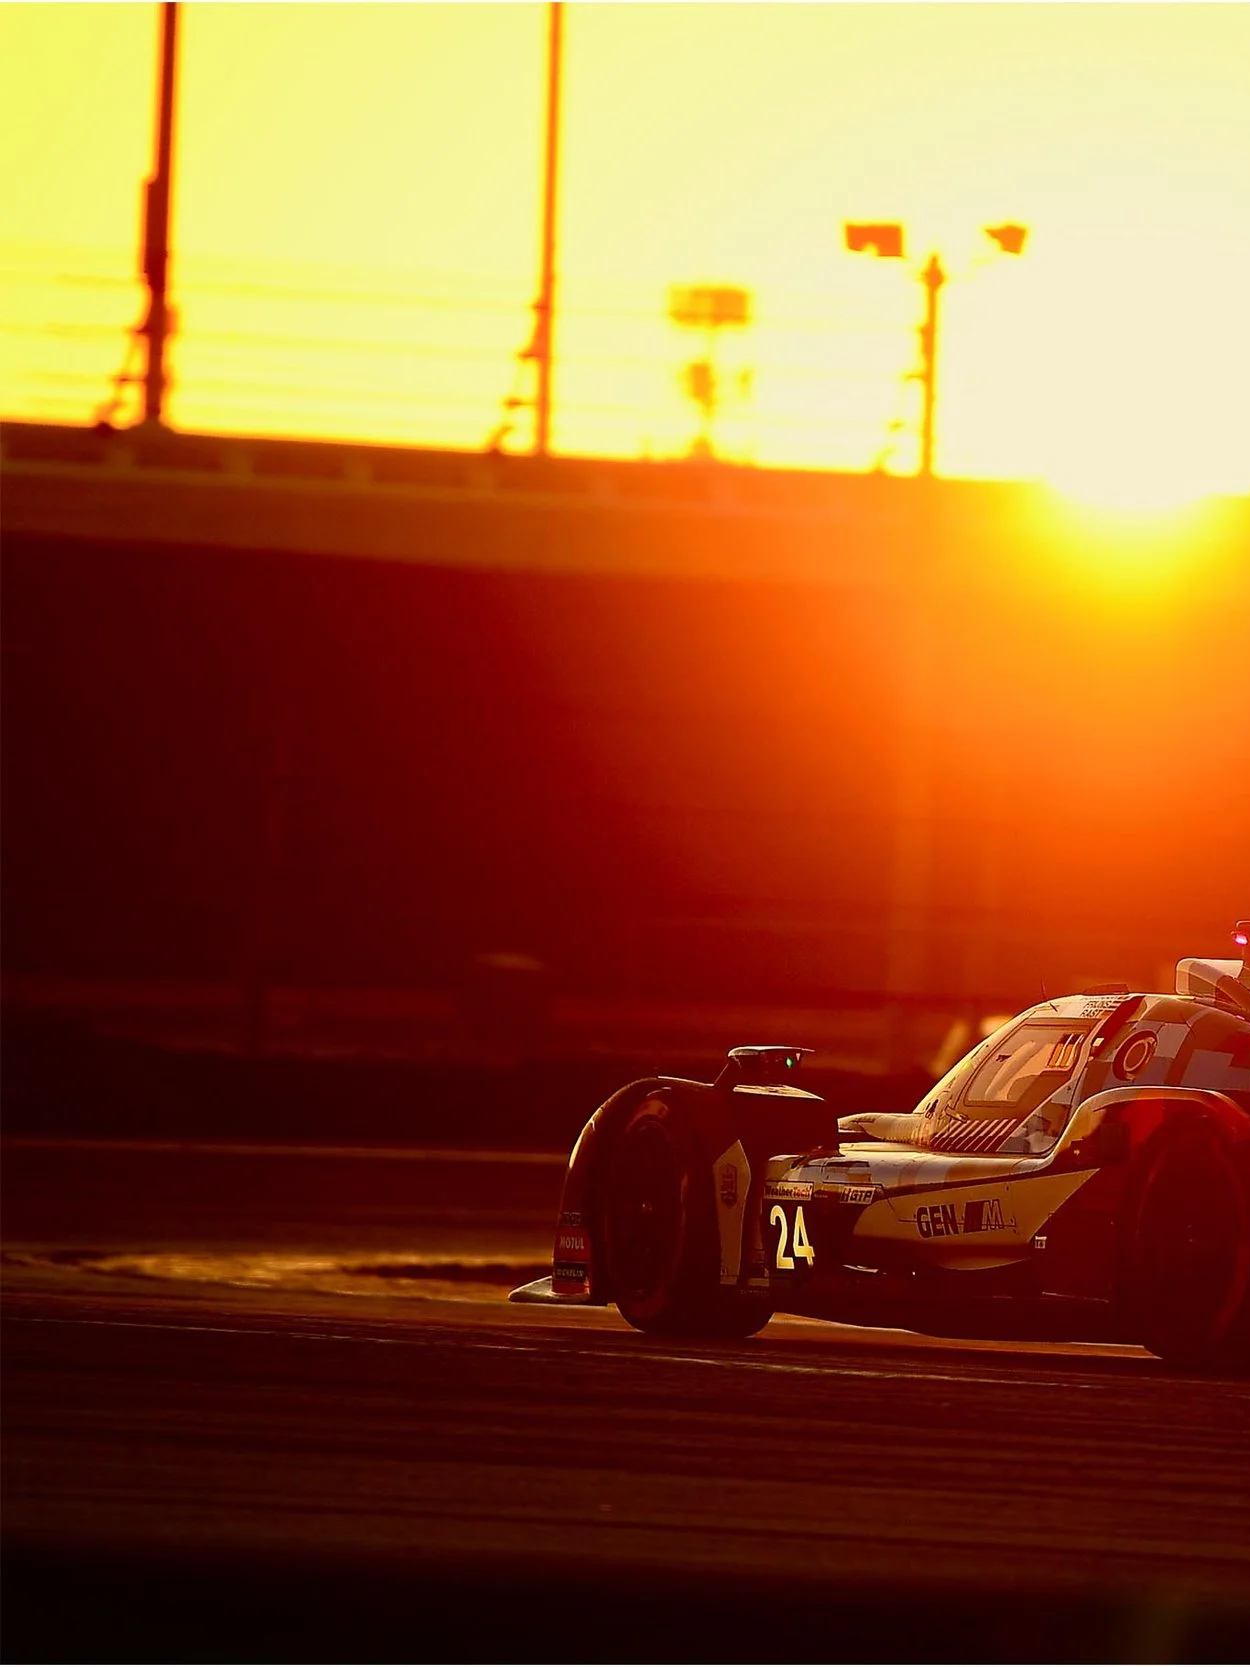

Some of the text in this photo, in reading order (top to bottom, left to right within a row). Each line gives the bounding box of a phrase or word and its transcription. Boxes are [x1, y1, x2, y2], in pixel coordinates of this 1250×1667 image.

[770, 1204, 816, 1270] 24
[916, 1203, 961, 1239] GEN
[560, 1235, 585, 1250] MOTUL
